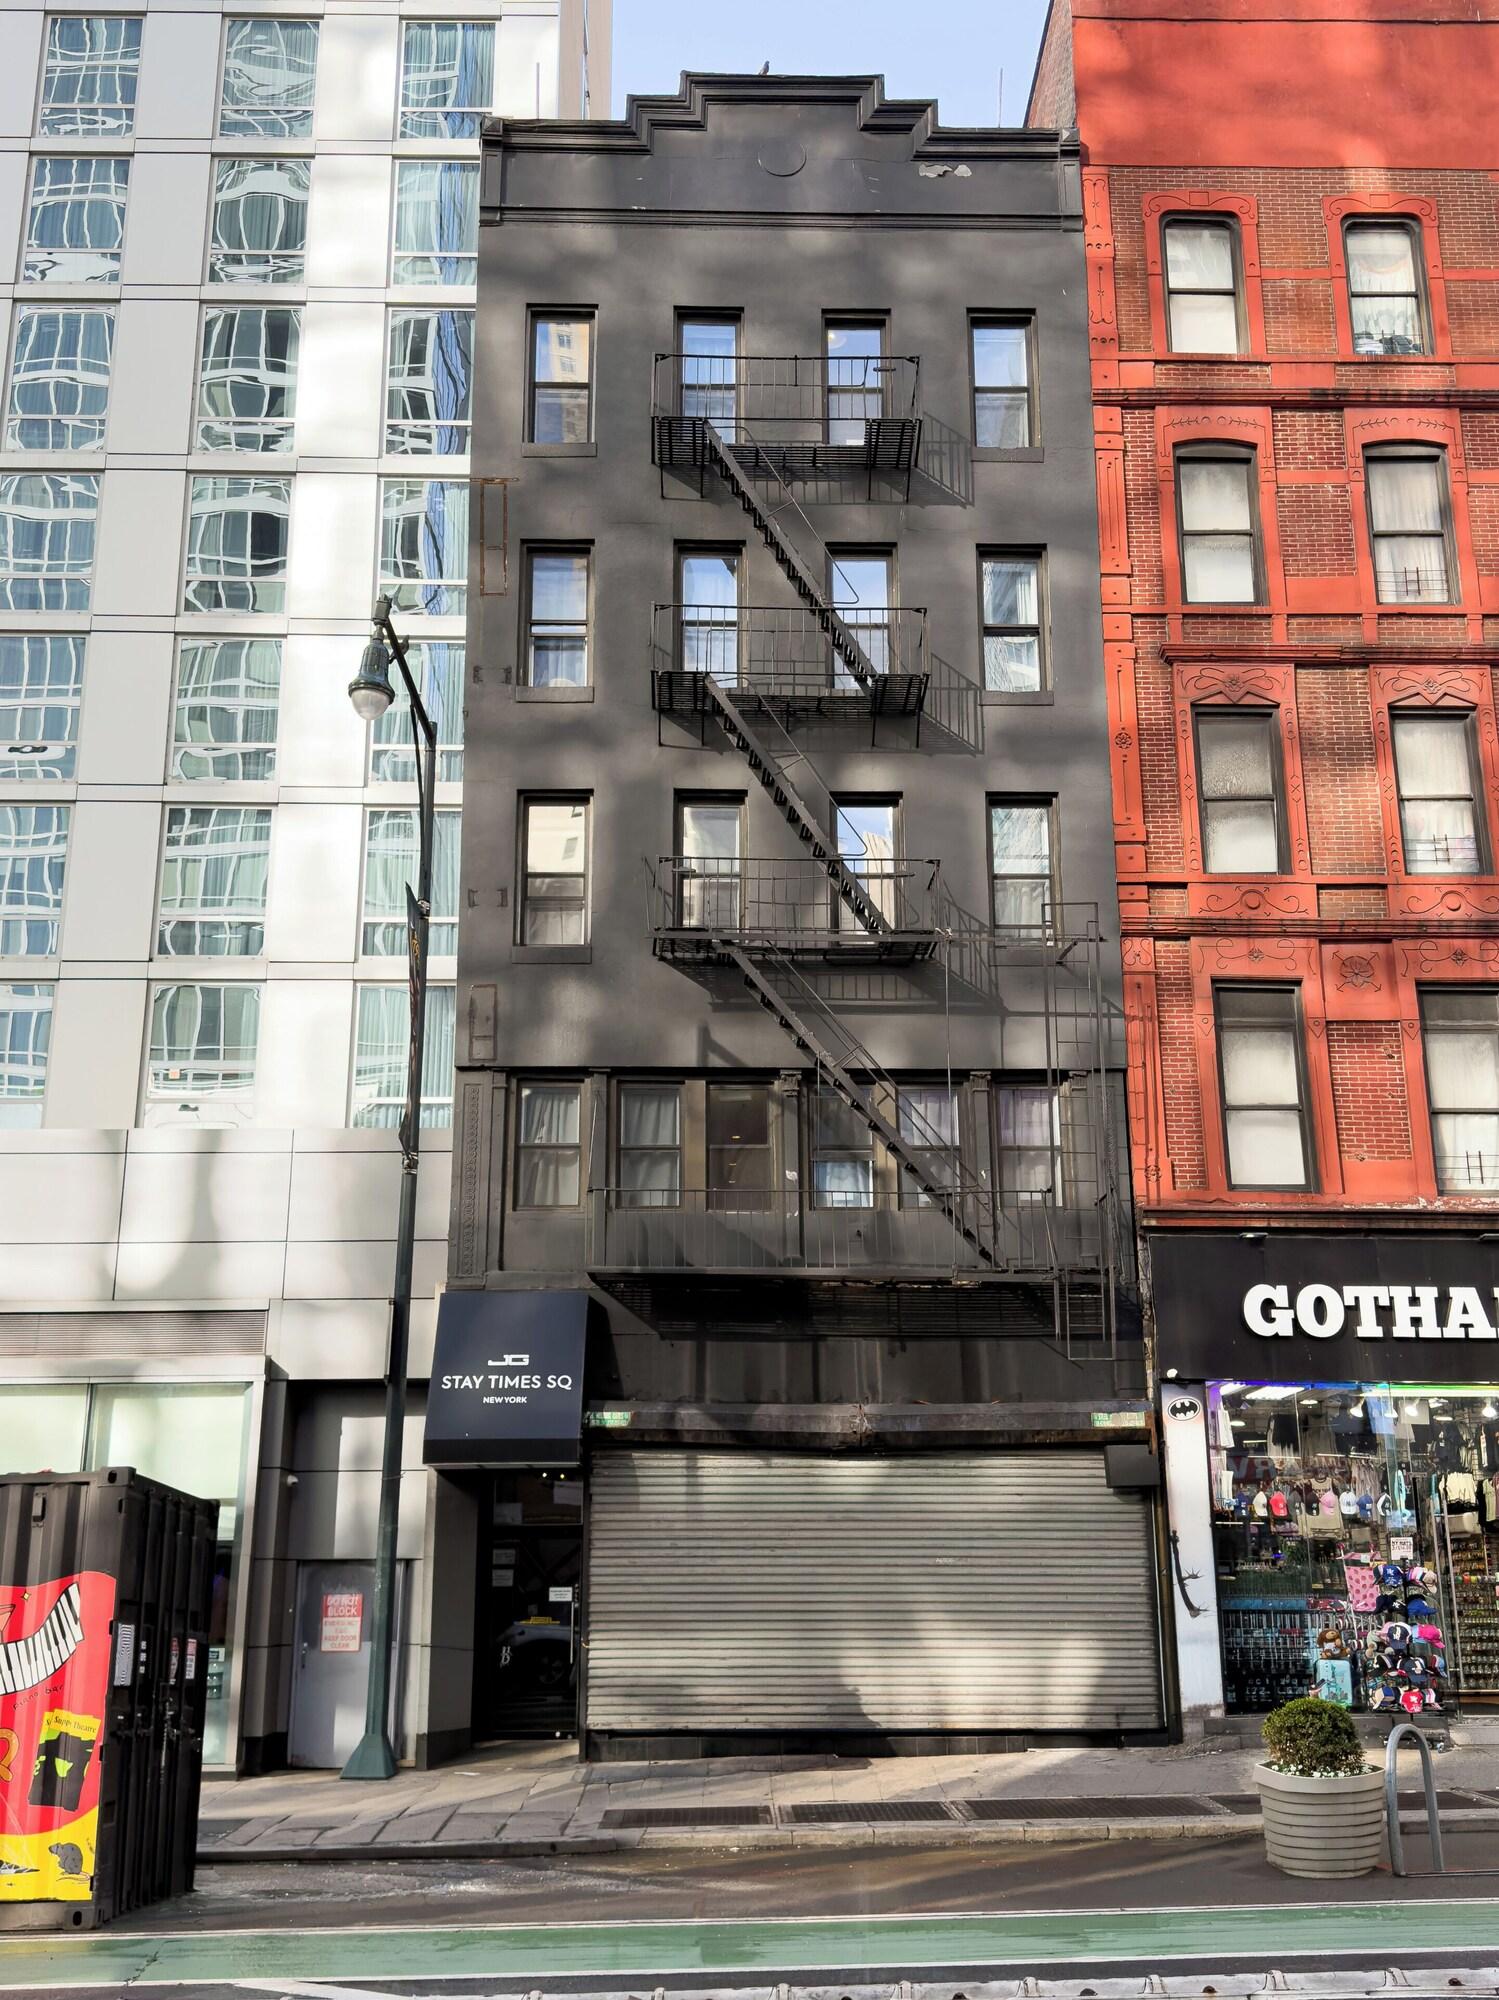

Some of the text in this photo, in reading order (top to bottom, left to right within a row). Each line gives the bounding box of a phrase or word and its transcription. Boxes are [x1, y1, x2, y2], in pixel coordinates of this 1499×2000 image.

[1243, 1283, 1499, 1338] GOTHA
[441, 1375, 572, 1390] STAY TIMES SQ
[483, 1396, 527, 1404] NEW YORK
[327, 1606, 357, 1616] BLOCK
